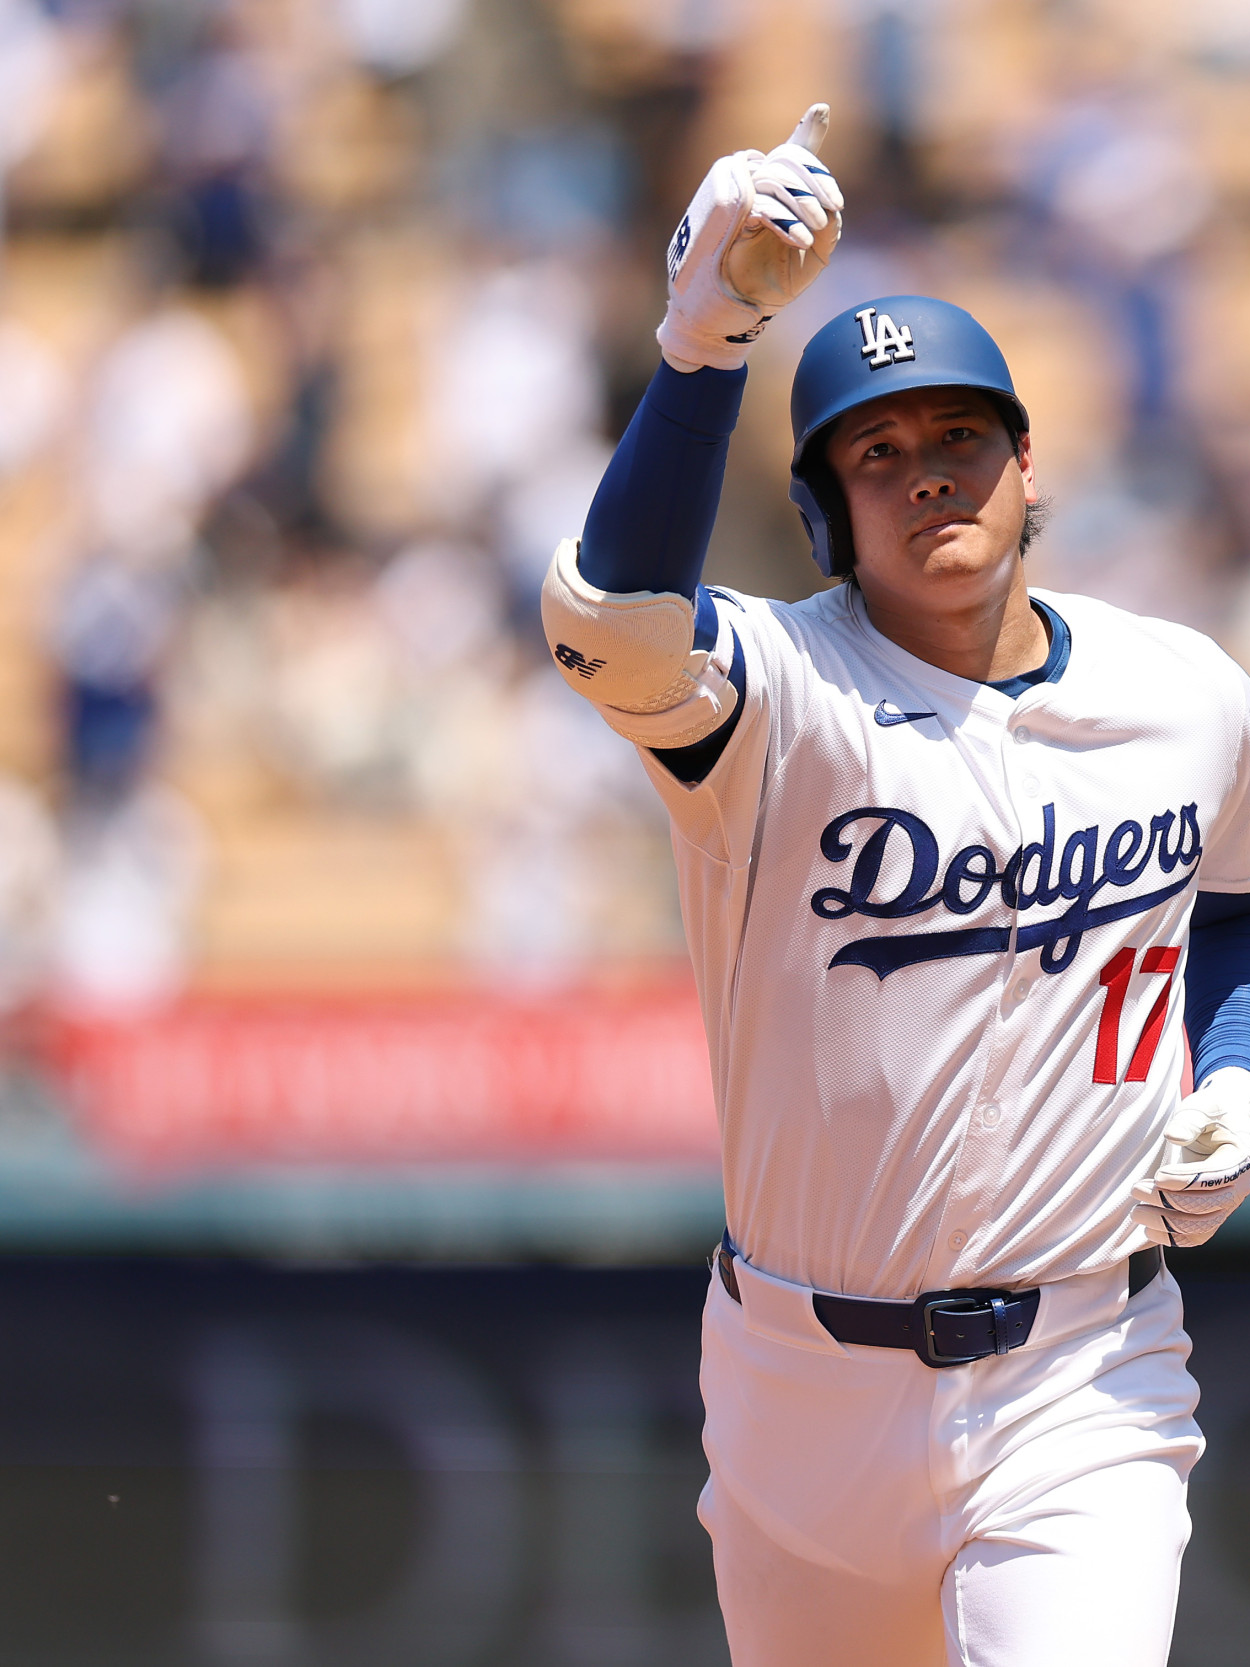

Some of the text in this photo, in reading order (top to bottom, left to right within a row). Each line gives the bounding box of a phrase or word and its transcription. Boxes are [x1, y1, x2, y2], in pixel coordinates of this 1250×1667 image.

[854, 307, 915, 371] LA
[810, 802, 1203, 976] Dodgers
[1092, 946, 1182, 1085] 17
[1200, 1178, 1224, 1188] new
